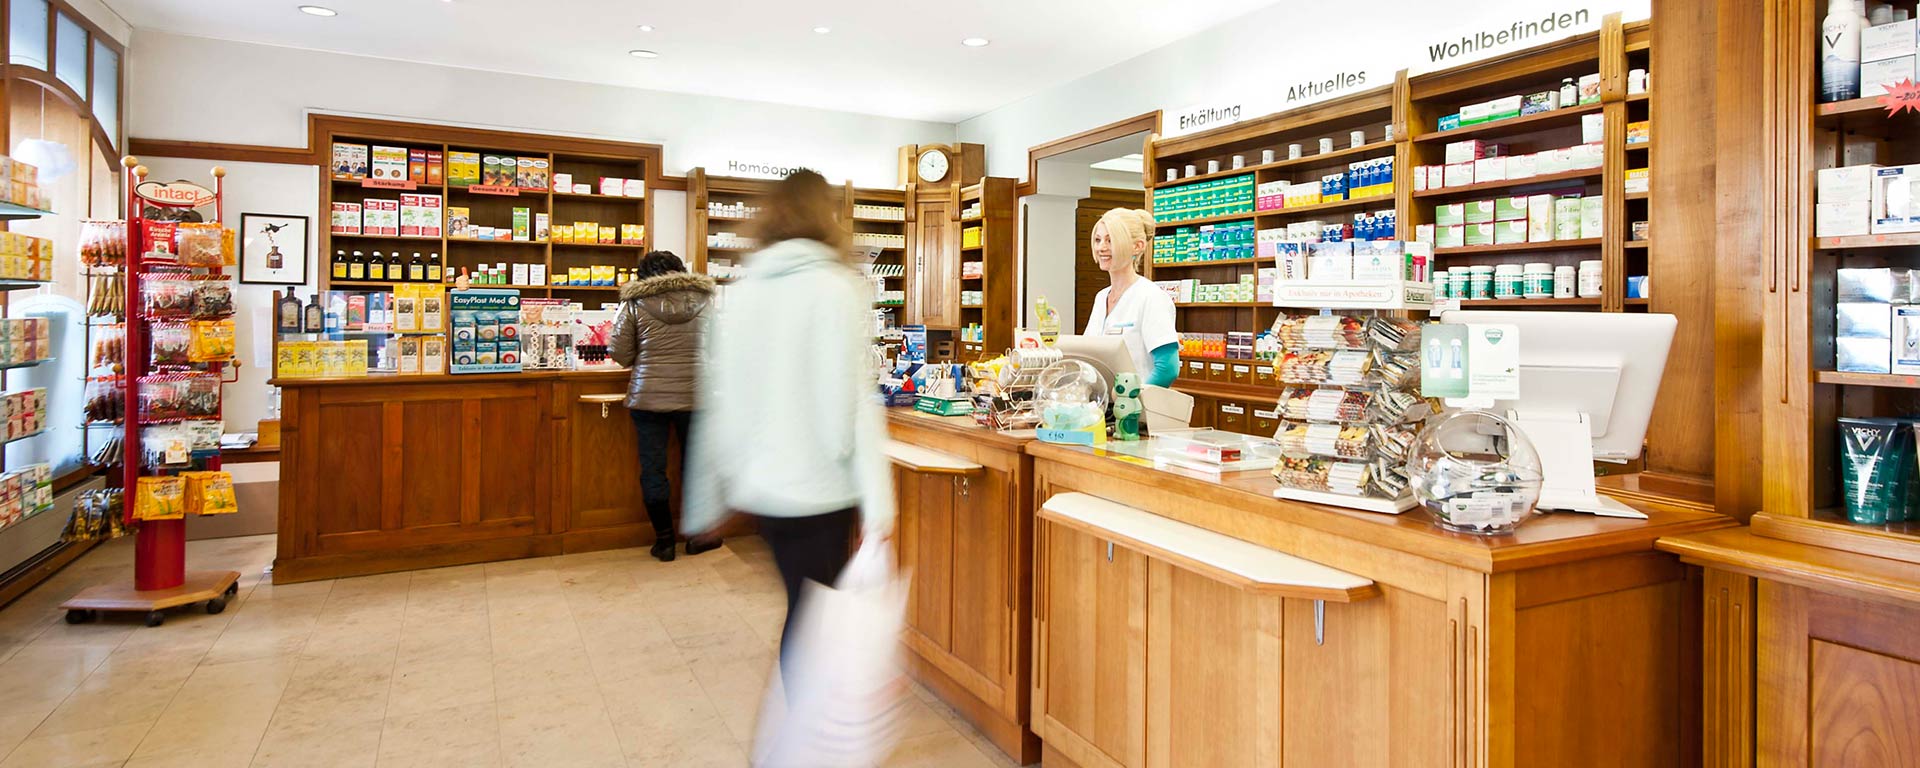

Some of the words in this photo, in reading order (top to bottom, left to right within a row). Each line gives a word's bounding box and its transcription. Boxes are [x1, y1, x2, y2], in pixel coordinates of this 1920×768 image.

[1428, 8, 1589, 62] Wohlbefinden
[1286, 71, 1366, 103] Aktuelles
[1180, 104, 1241, 130] Erkältung
[728, 160, 822, 177] Homöopae
[154, 186, 200, 202] intact
[453, 295, 487, 305] EasyPlast
[488, 296, 506, 304] Med
[1343, 289, 1382, 299] Apotheken
[1851, 427, 1880, 437] VICHY
